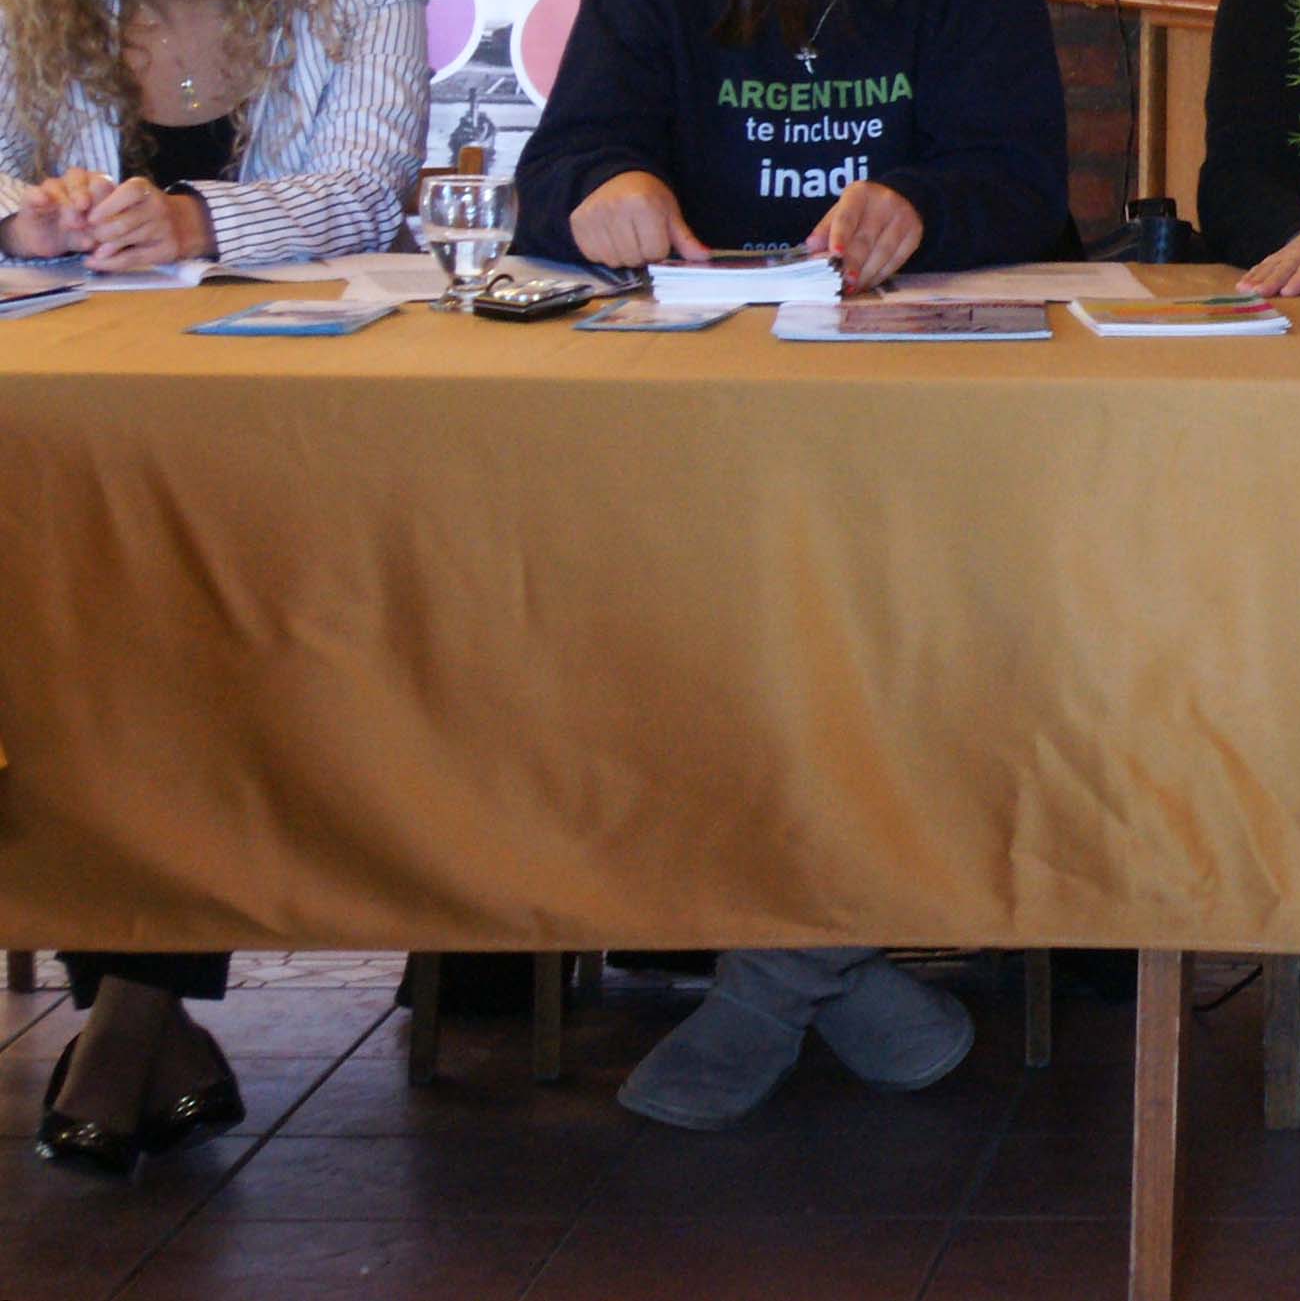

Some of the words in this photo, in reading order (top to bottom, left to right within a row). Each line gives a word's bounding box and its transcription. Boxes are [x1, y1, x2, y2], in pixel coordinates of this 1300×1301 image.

[717, 72, 913, 112] ARGENTINA
[745, 116, 775, 142] te
[783, 115, 884, 145] incluye
[759, 155, 869, 198] inadi
